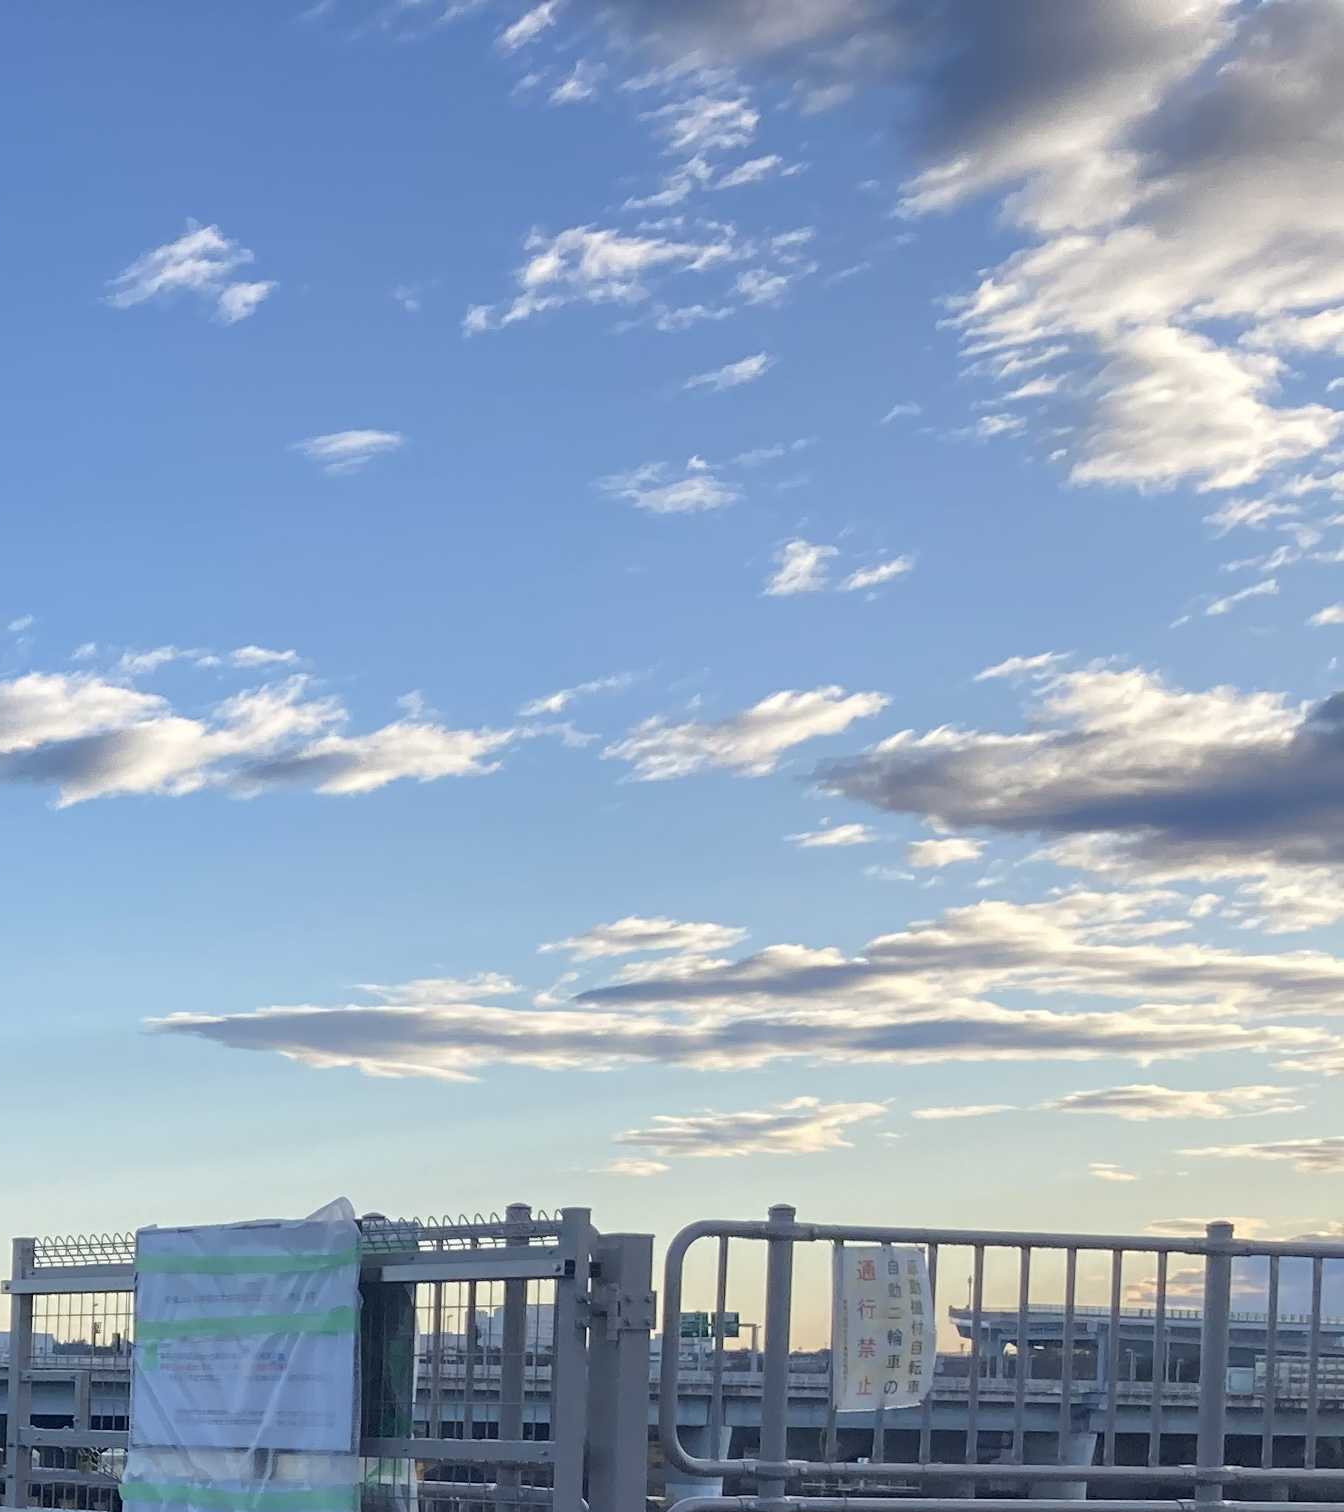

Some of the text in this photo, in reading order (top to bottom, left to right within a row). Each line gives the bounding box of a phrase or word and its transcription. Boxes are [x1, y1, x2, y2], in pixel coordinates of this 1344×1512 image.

[856, 1260, 877, 1396] 通行禁止
[883, 1260, 903, 1395] 自動二輪車の
